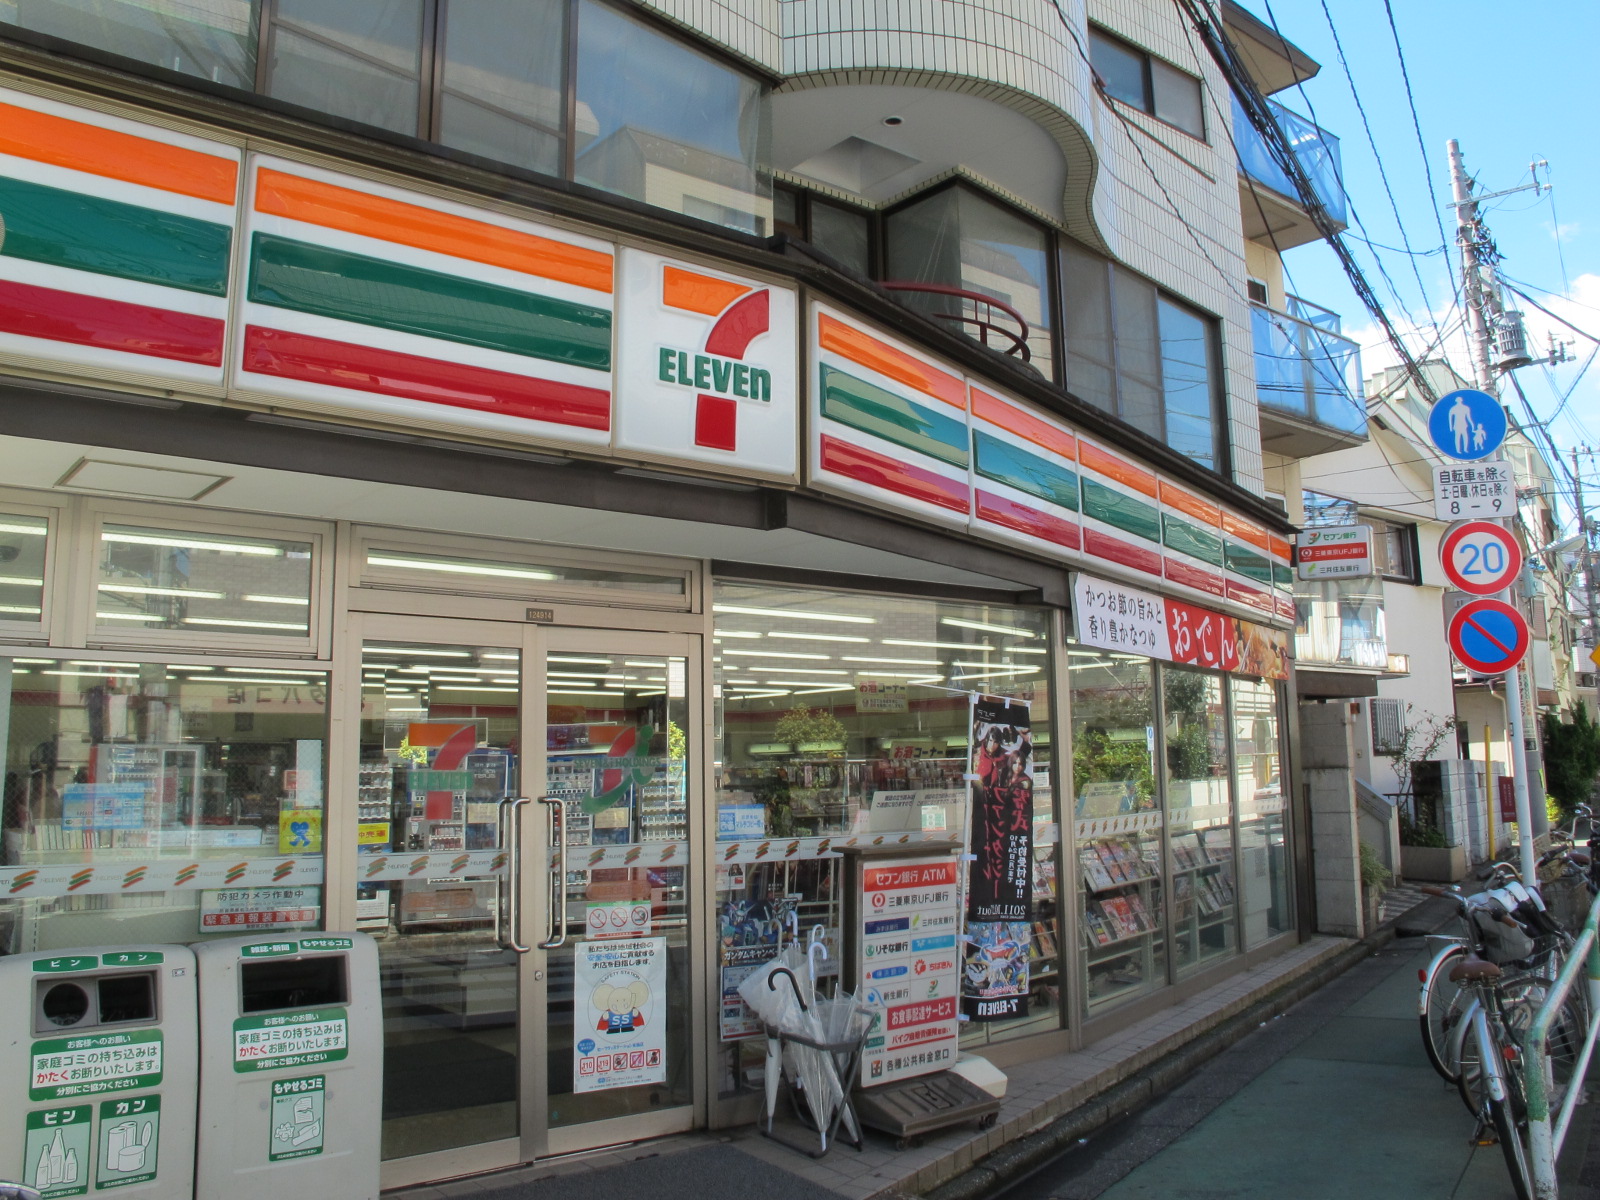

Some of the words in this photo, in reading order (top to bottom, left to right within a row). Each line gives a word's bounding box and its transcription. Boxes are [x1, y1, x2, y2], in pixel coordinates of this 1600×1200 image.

[1439, 467, 1507, 484] 自転車を除く
[1451, 501, 1461, 514] 8
[1492, 498, 1502, 512] 9
[1459, 541, 1504, 575] 20
[1085, 585, 1162, 625] かつお節の旨みと
[529, 611, 552, 620] 124914
[1088, 614, 1156, 649] 香り豊かなつゆ
[1172, 607, 1234, 666] おでん
[894, 745, 944, 758] お酒コーナー
[876, 869, 918, 886] セブン銀行
[922, 867, 946, 882] ATM
[217, 889, 304, 902] 防犯カメラ作動中
[888, 891, 949, 907] 三菱東京UFJ銀行
[922, 915, 954, 928] 三井住友銀行
[302, 938, 350, 948] もやせるゴミ
[588, 941, 654, 953] 私たちは地域社会の
[875, 941, 908, 955] りそな銀行
[51, 958, 80, 968] ビン
[120, 953, 147, 962] カン
[592, 958, 651, 969] お店を目指します。
[600, 971, 619, 984] SAFETY
[883, 988, 909, 1001] 新生銀行
[263, 1012, 320, 1026] お客様へのお願い
[612, 1014, 630, 1025] SS
[891, 1002, 952, 1026] お食事配達サービス
[67, 1034, 131, 1049] お客様へのお願い
[238, 1023, 343, 1045] 家庭ゴミの持ち込みは
[238, 1036, 345, 1057] かたくお断りいたします。
[36, 1046, 158, 1071] 家庭ゴミの持ち込みは
[256, 1052, 327, 1069] 分別にご協力ください
[886, 1048, 949, 1072] 各種公共料金窓口
[36, 1060, 160, 1084] かたくお断りいたします。
[56, 1077, 139, 1096] 分別にご協力ください
[274, 1077, 323, 1093] もやせるゴミ
[116, 1099, 146, 1115] カン
[43, 1109, 76, 1125] ビン
